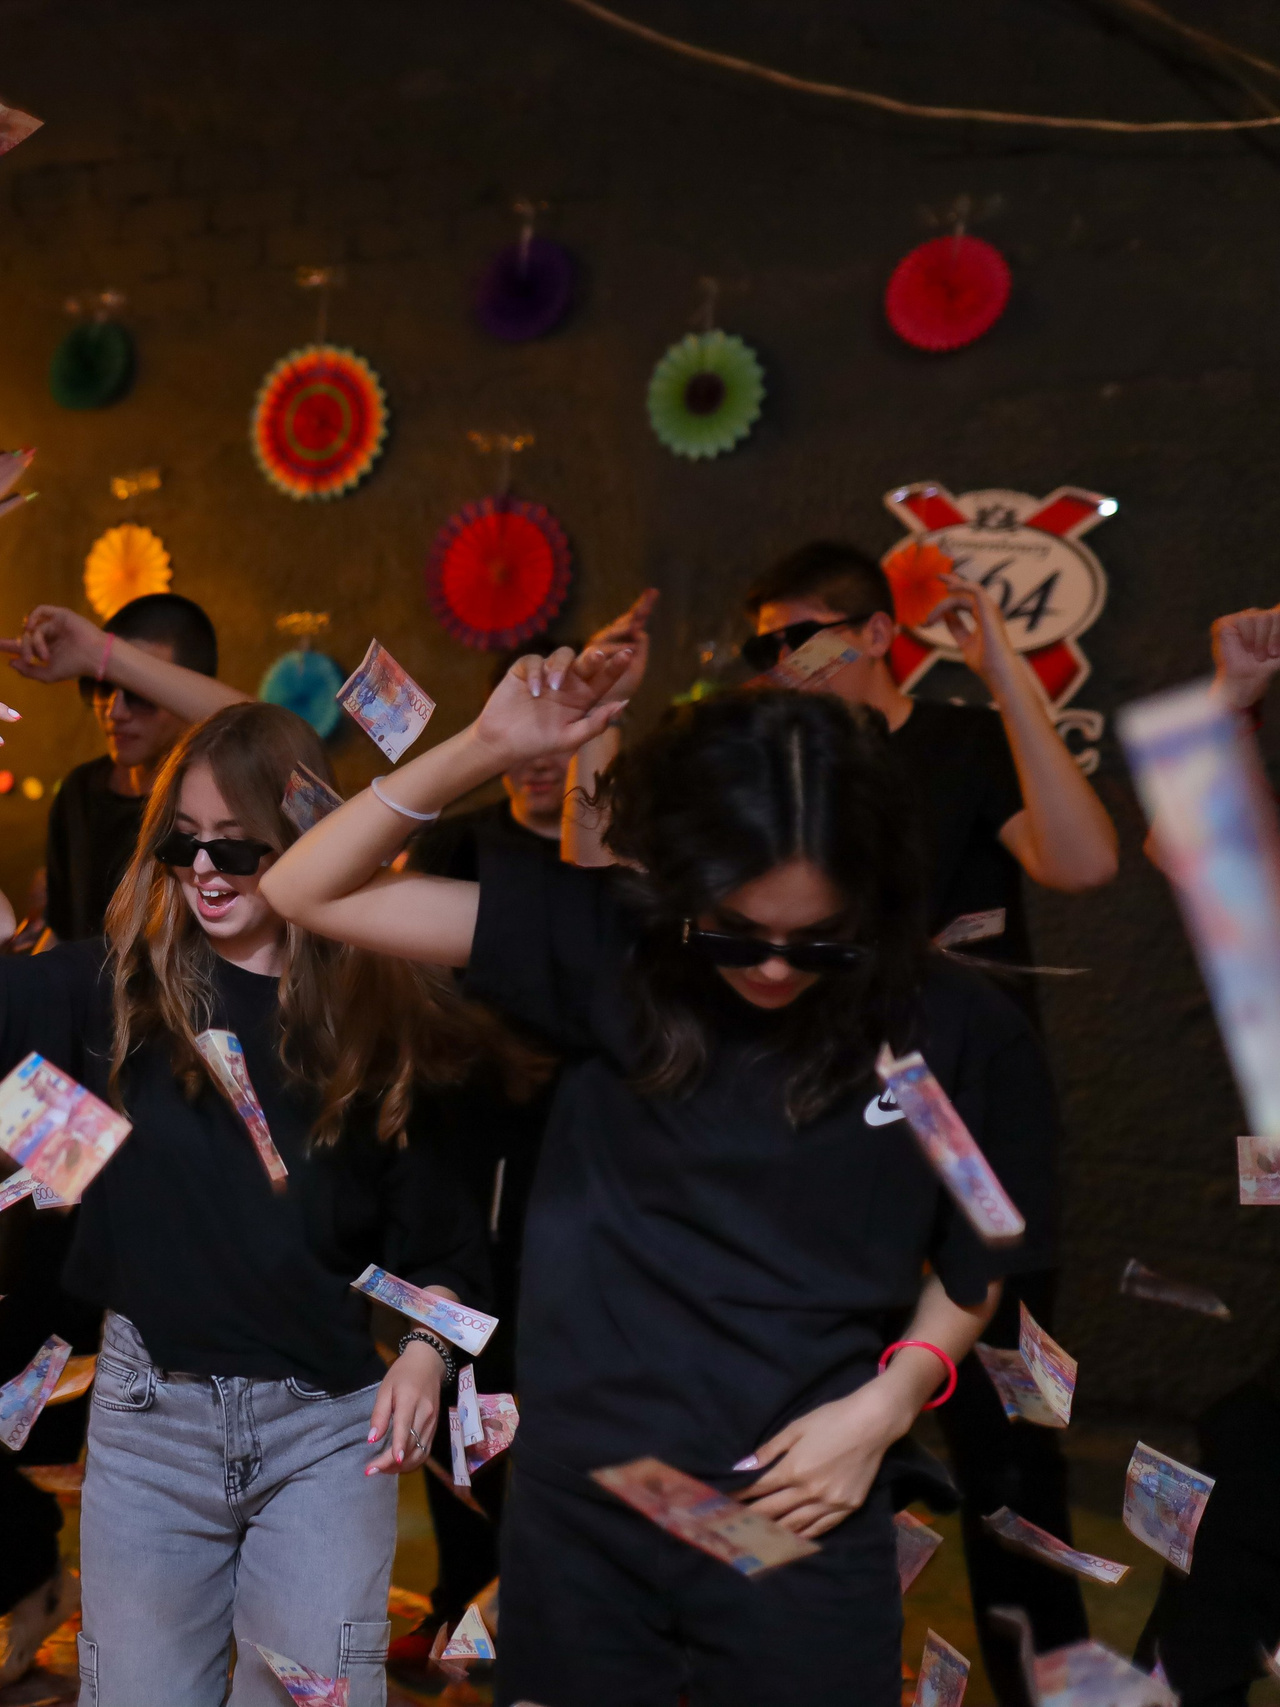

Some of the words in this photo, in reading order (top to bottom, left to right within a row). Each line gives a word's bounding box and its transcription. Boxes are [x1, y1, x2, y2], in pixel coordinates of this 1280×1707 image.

[410, 694, 430, 720] 5000
[453, 1312, 490, 1333] 5000
[8, 1416, 30, 1443] 5000
